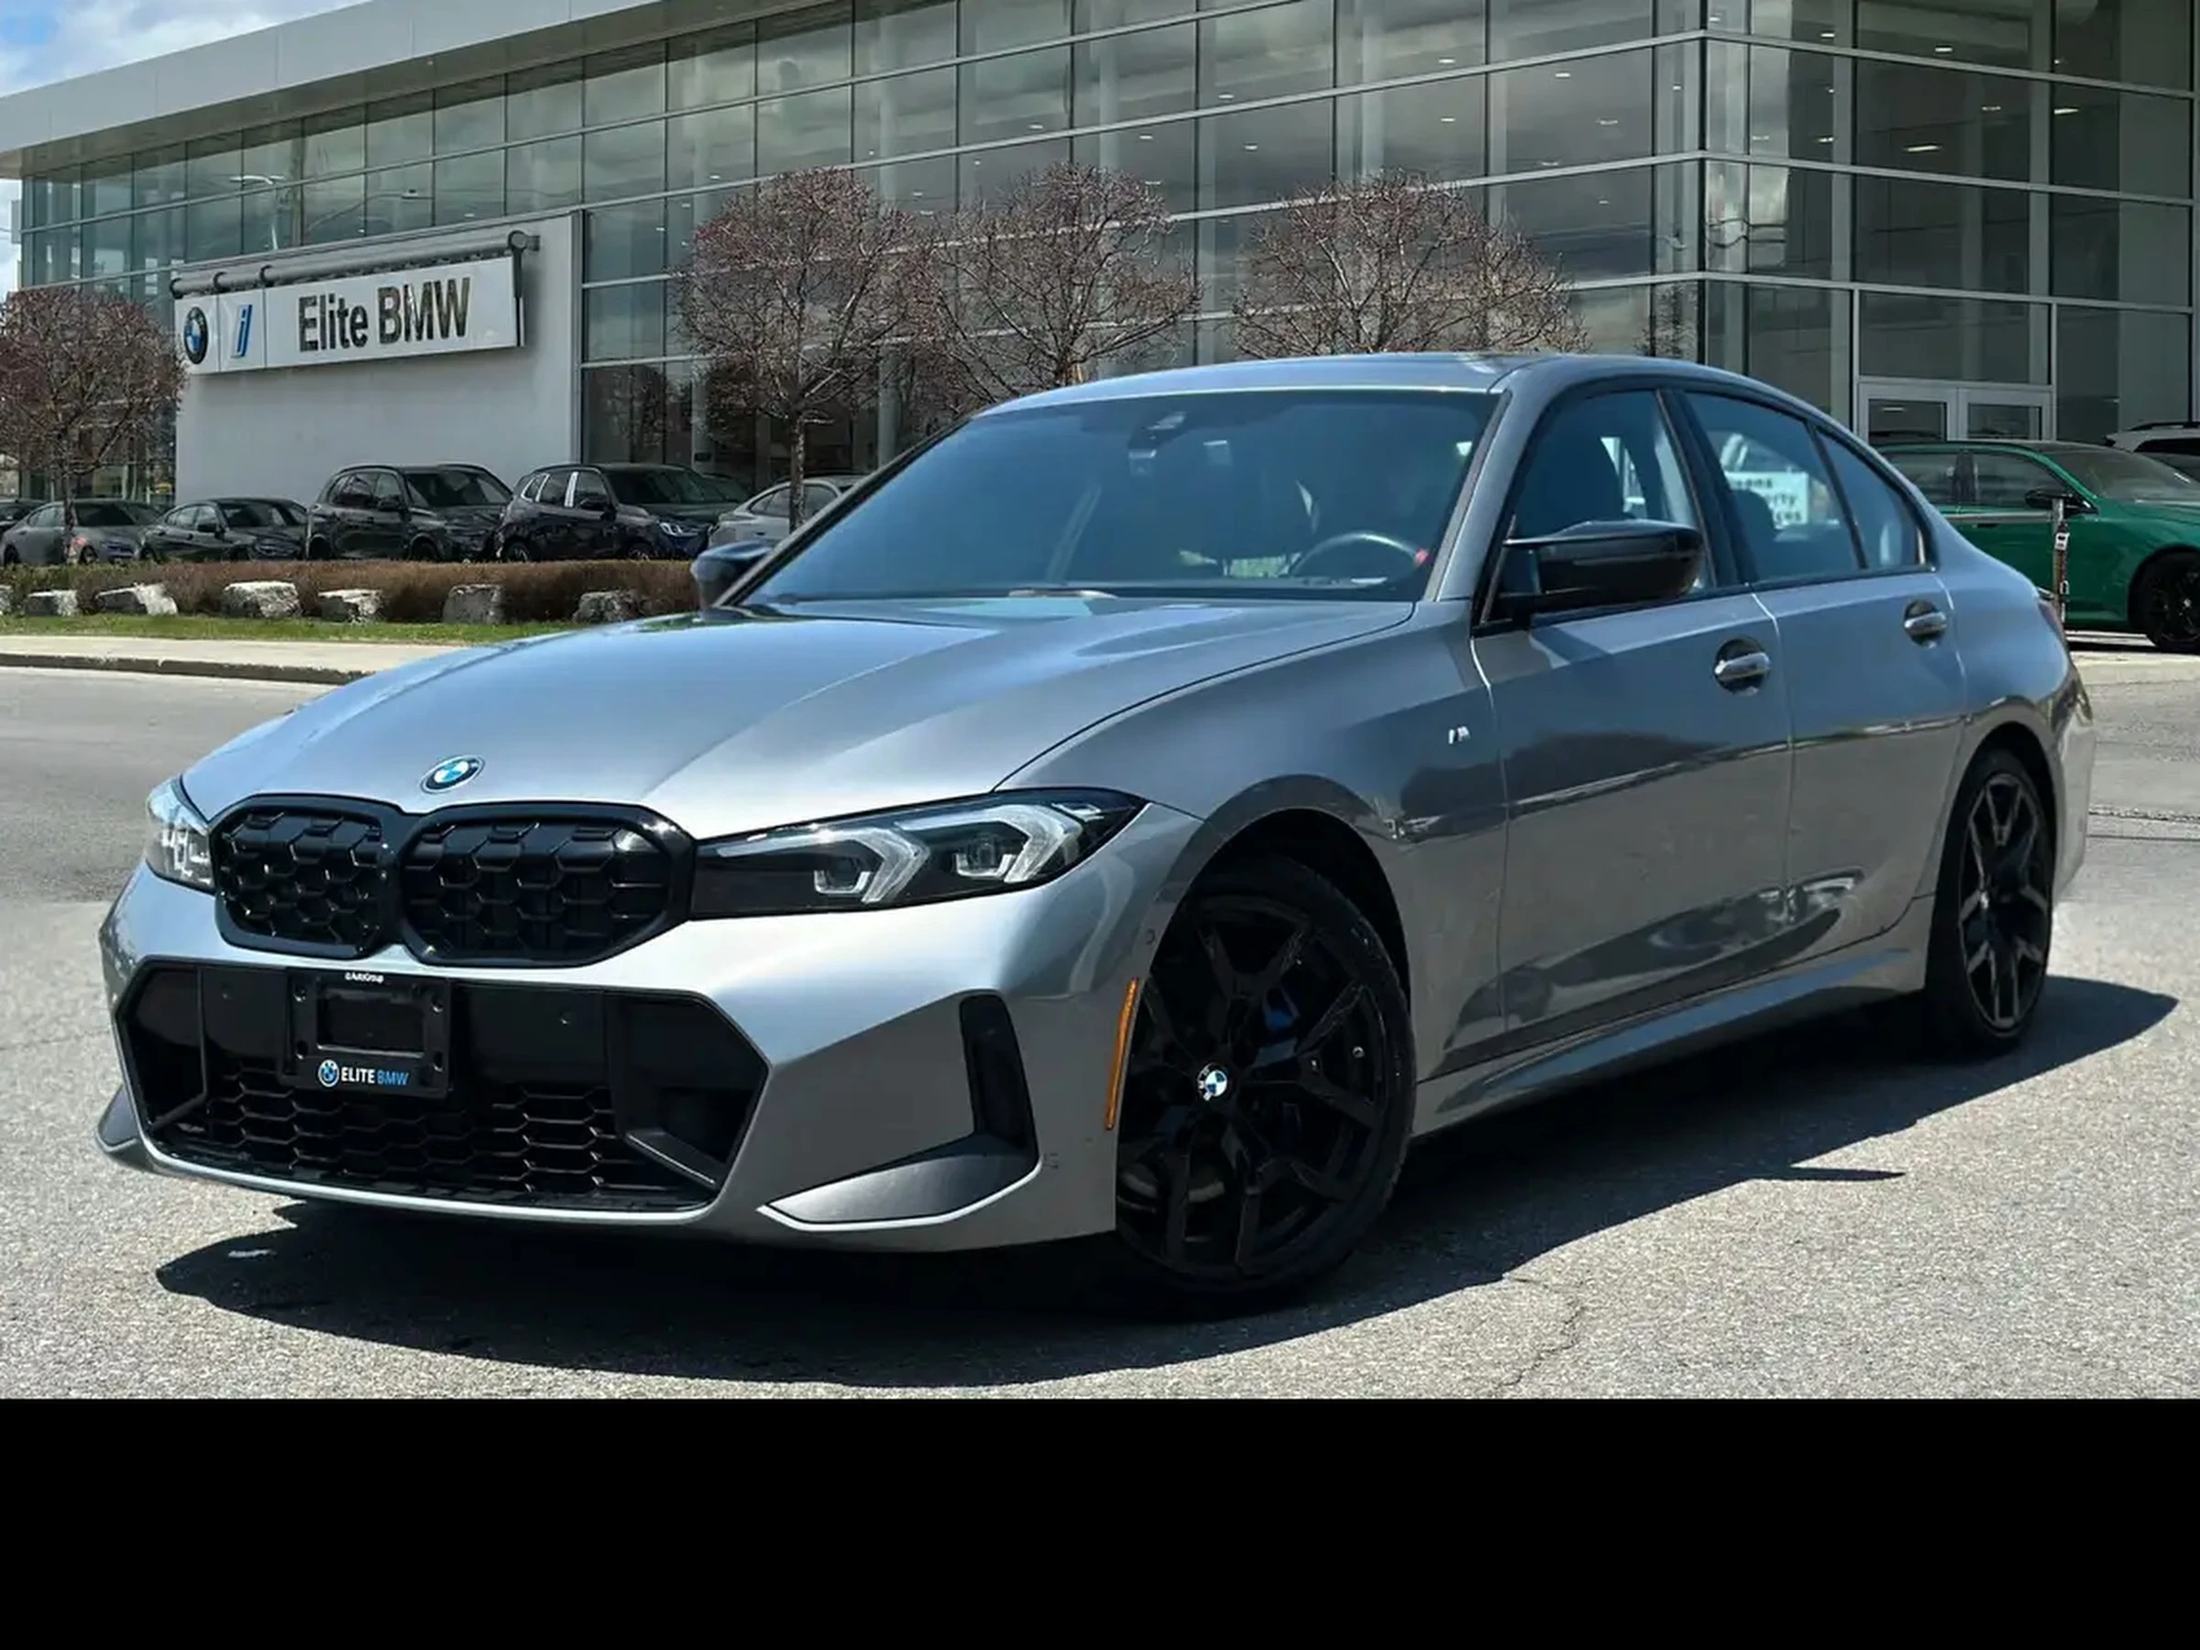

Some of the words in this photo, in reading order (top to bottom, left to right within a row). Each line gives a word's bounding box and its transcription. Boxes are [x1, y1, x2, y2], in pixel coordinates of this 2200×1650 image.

[299, 293, 369, 353] Elite
[377, 276, 472, 345] BMW
[341, 1066, 375, 1084] ELITE
[377, 1070, 409, 1085] BMW
